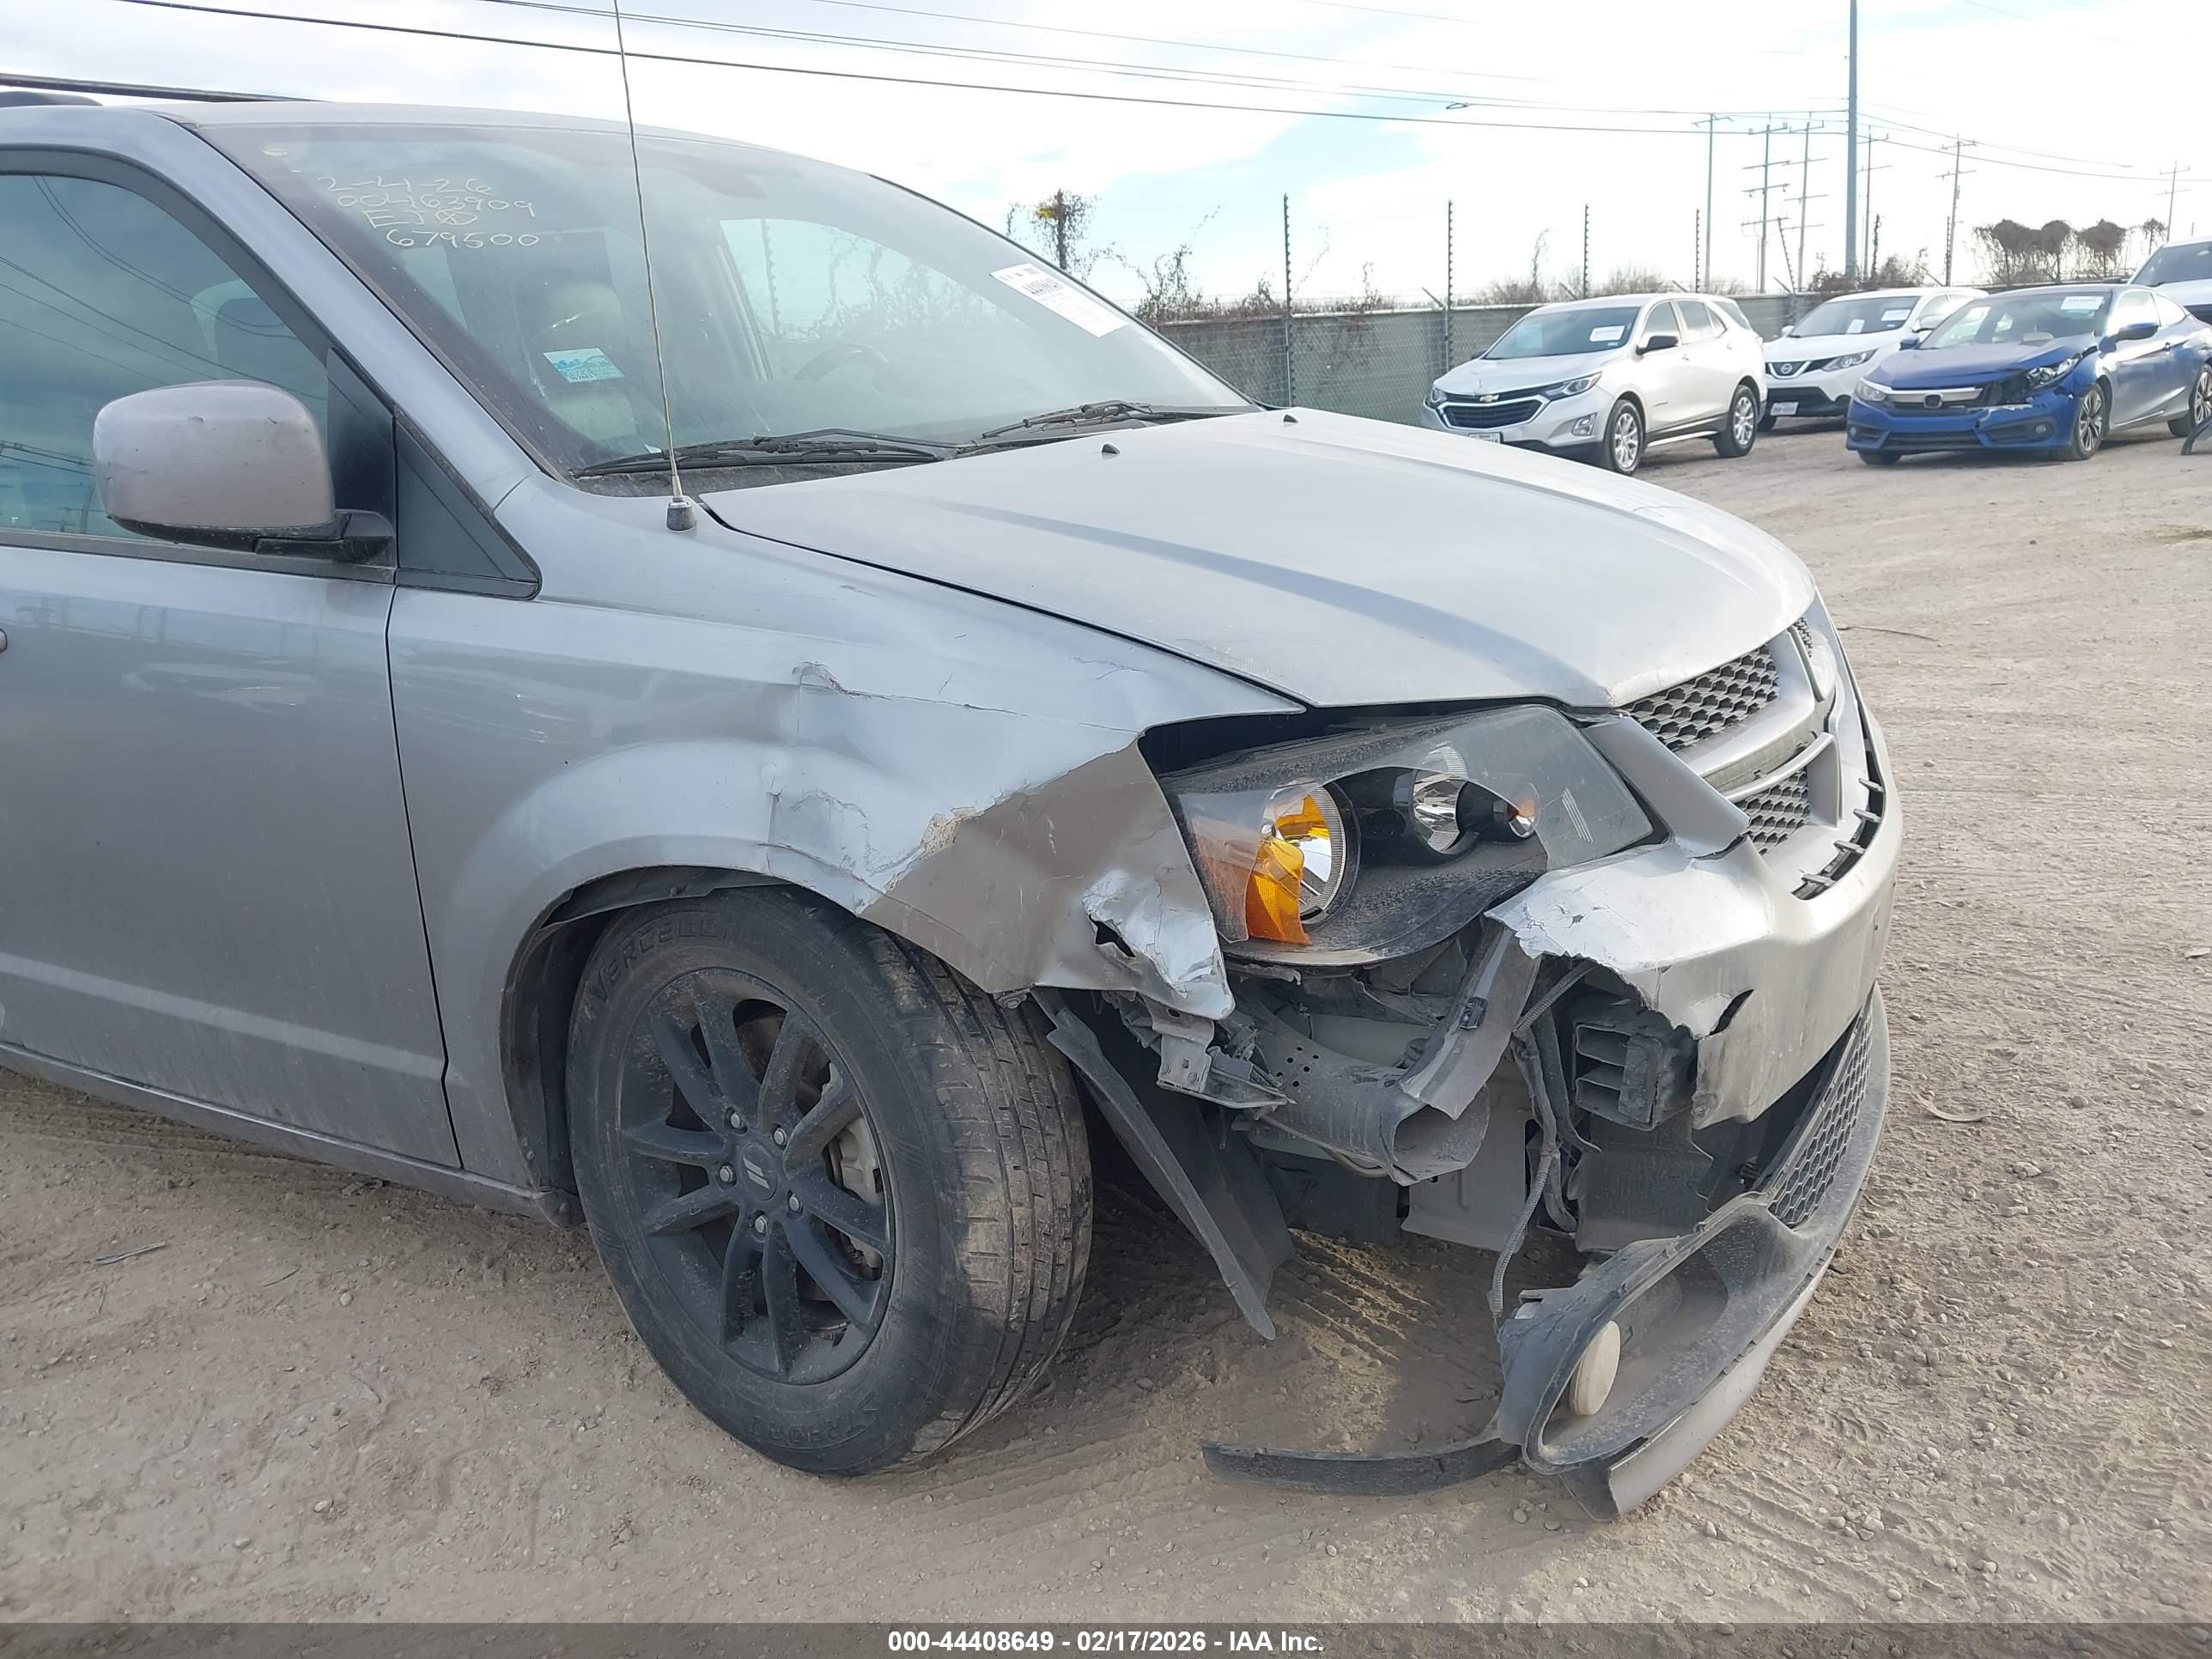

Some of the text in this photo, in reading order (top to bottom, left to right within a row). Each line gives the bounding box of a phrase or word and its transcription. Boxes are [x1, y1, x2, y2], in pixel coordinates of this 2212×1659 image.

[317, 175, 495, 196] 2-4-26
[337, 192, 537, 218] 00463909
[386, 228, 540, 249] 679500
